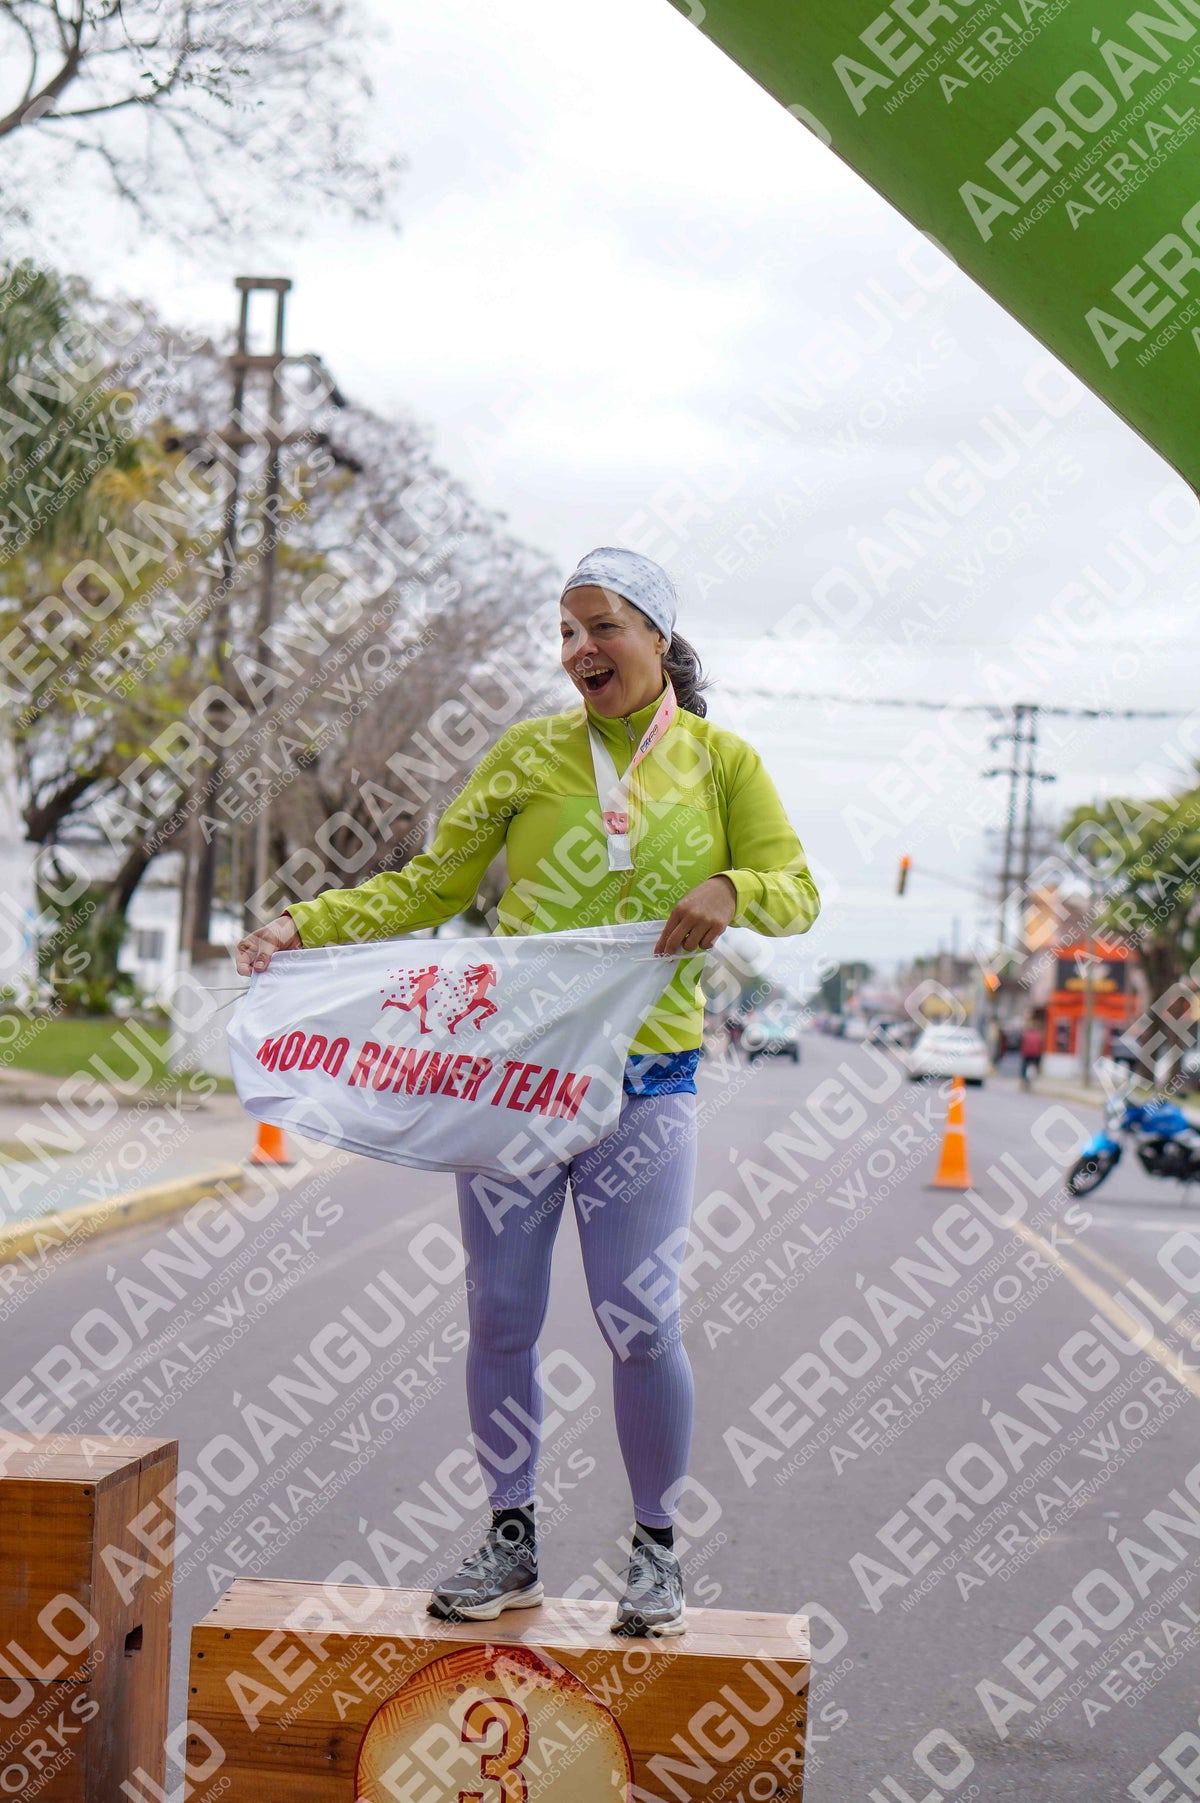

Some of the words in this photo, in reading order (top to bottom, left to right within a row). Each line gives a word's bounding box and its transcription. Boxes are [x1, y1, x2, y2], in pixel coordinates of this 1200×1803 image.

[256, 1030, 350, 1079] MODO
[348, 1041, 493, 1101] RUNNER
[491, 1060, 592, 1121] TEAM
[457, 1696, 530, 1803] 3
